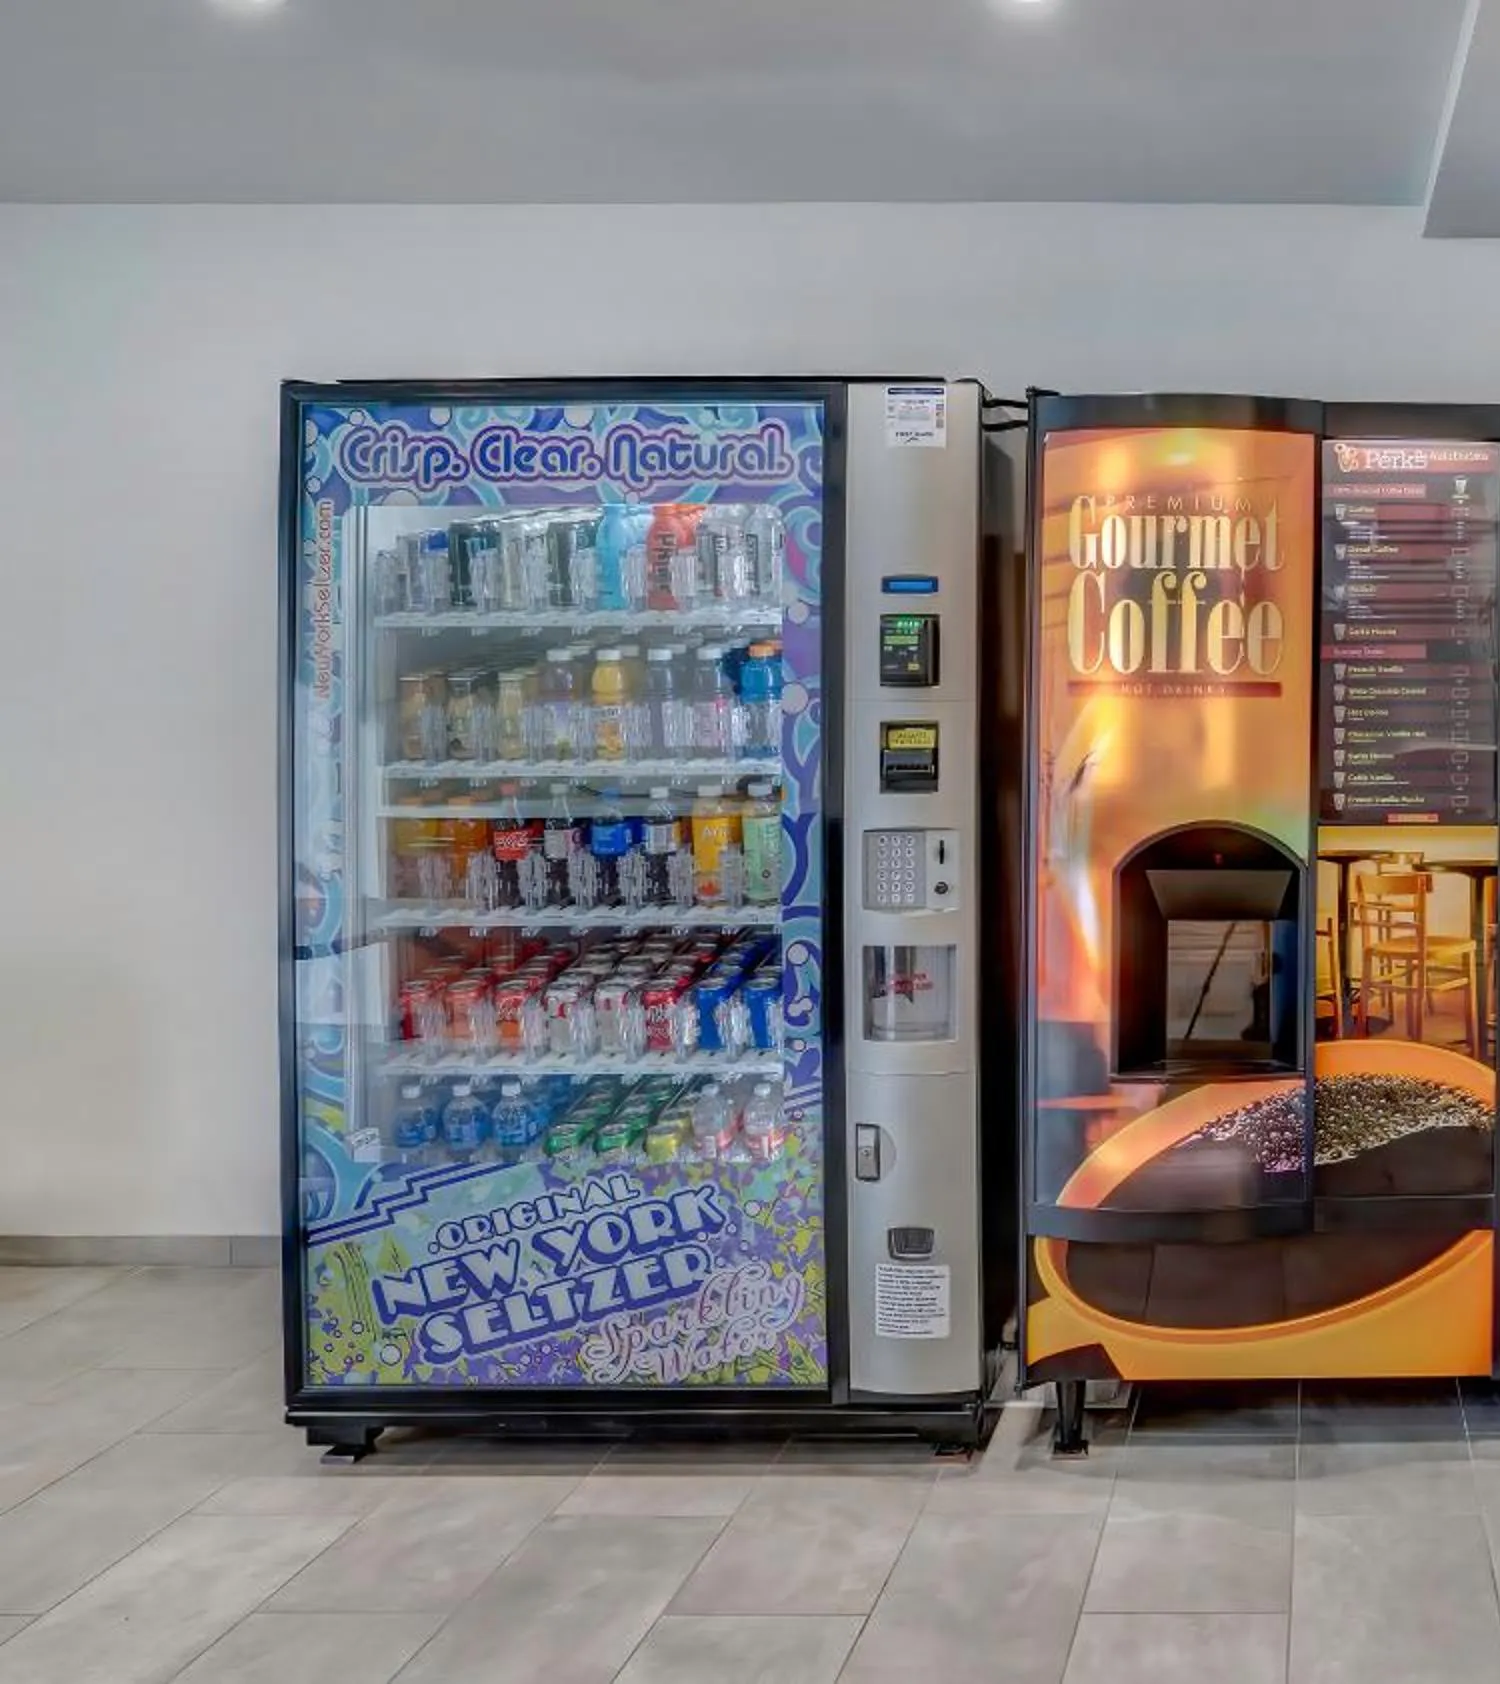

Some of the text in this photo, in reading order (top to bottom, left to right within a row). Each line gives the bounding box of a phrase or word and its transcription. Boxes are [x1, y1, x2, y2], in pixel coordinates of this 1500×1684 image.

[344, 424, 789, 485] Crisp. Clear. Natural.
[1068, 495, 1286, 572] Gourmet
[1106, 494, 1252, 512] PREMIUM
[1066, 571, 1285, 676] Coffee
[435, 1174, 641, 1254] ORIGINAL
[372, 1186, 728, 1325] NEW YORK
[418, 1245, 714, 1365] SELTZER
